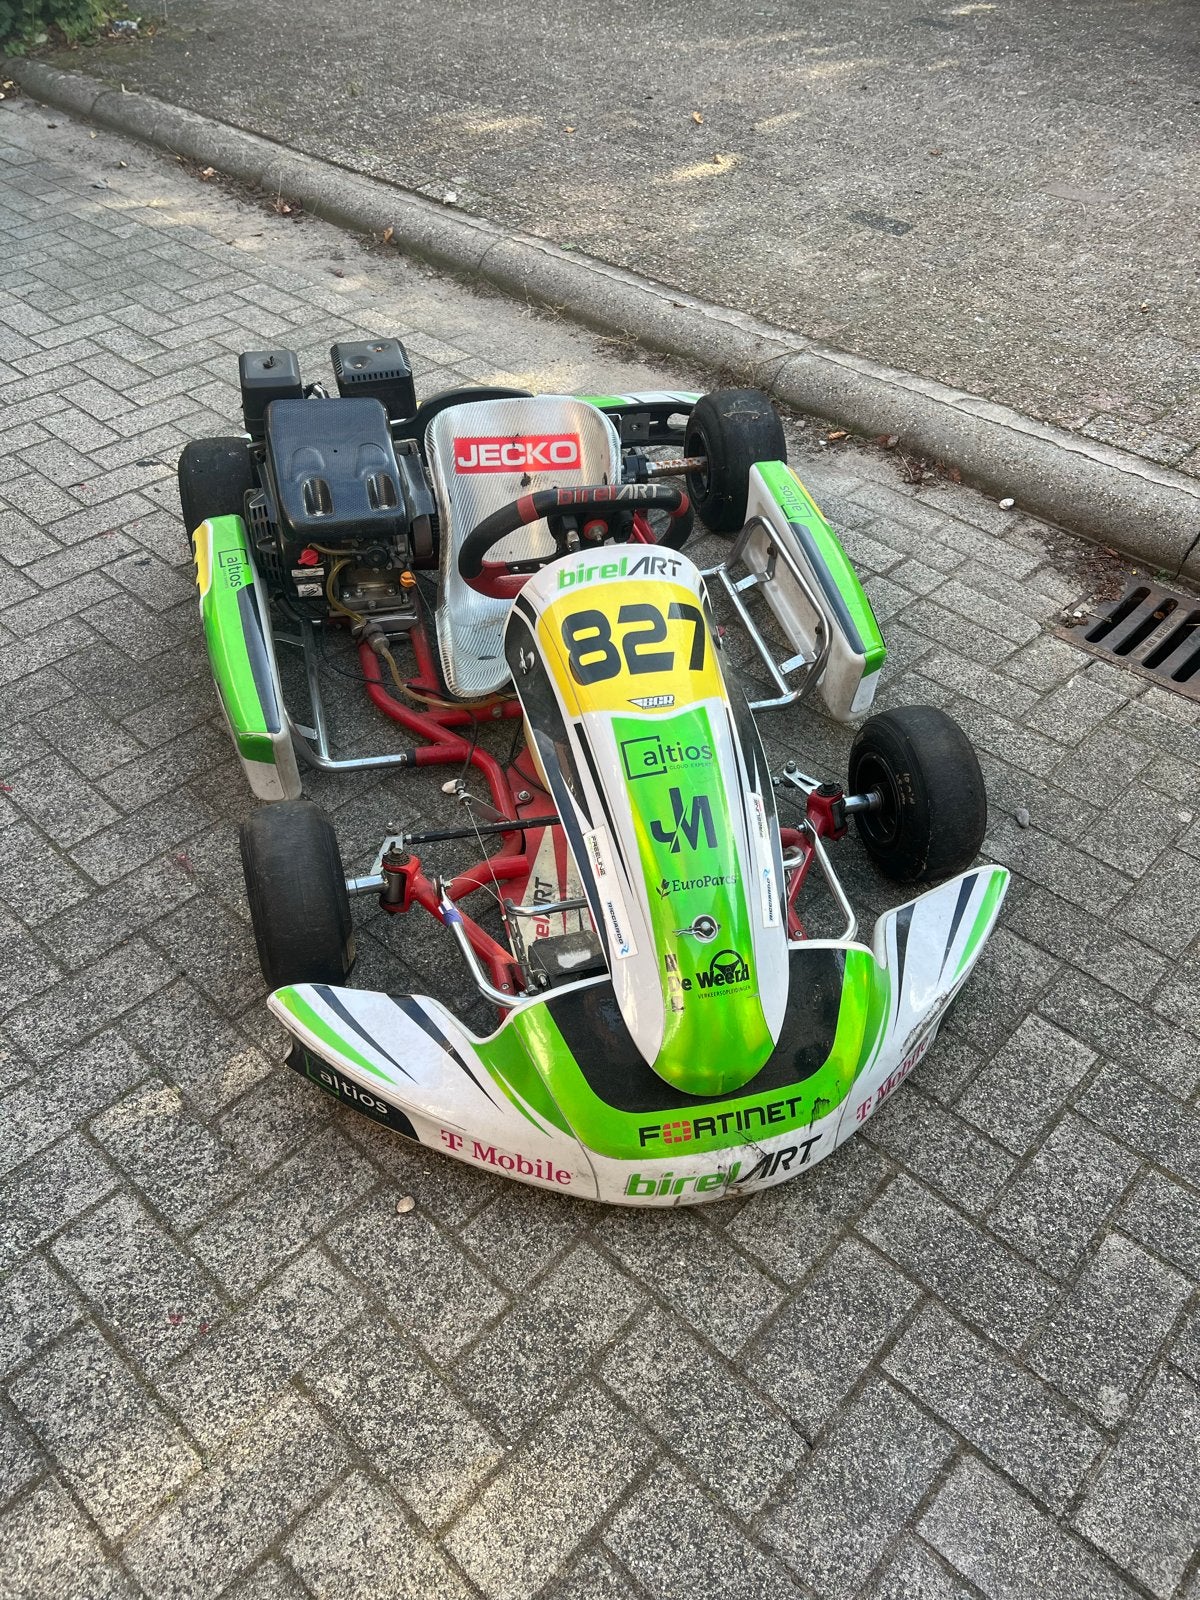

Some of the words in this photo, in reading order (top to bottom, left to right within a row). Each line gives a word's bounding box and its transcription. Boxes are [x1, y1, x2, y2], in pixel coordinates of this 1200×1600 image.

[457, 440, 578, 467] JECKO
[557, 483, 663, 506] birelART
[780, 485, 802, 511] altios
[227, 557, 244, 587] altios
[558, 556, 682, 588] birelART
[561, 602, 706, 686] 827
[643, 741, 713, 767] altios
[650, 787, 718, 853] JM
[672, 874, 737, 892] EuroParcs
[607, 901, 624, 945] RICCIARDO
[695, 964, 750, 989] Weerd
[320, 1069, 388, 1114] altios
[638, 1097, 803, 1147] FORTINET
[471, 1141, 572, 1185] Mobile
[625, 1134, 823, 1198] birelART
